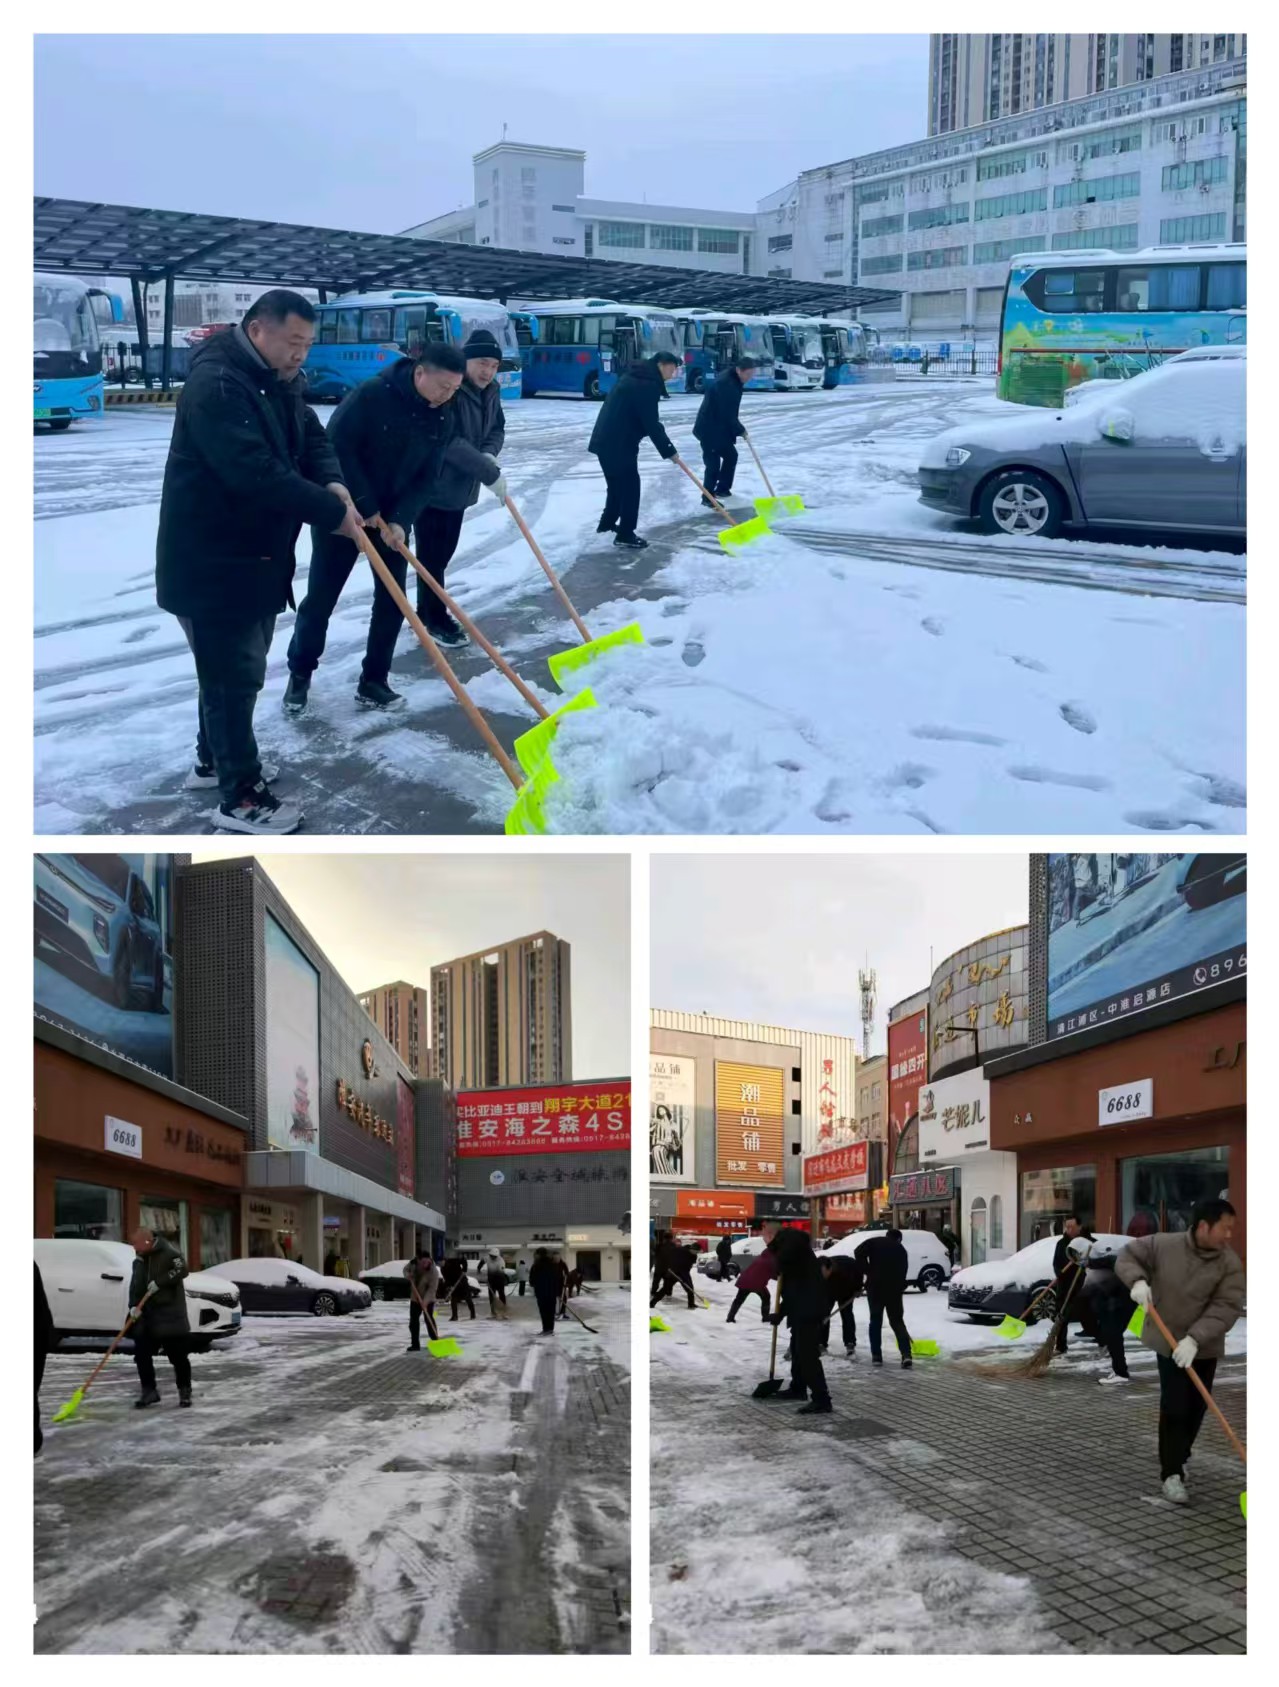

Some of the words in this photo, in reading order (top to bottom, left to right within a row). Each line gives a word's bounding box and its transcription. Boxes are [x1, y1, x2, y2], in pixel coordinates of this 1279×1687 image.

[941, 1099, 986, 1133] 芒妮儿
[1107, 1092, 1142, 1113] 6688
[740, 1082, 761, 1152] 潮品铺
[113, 1128, 137, 1148] 6688
